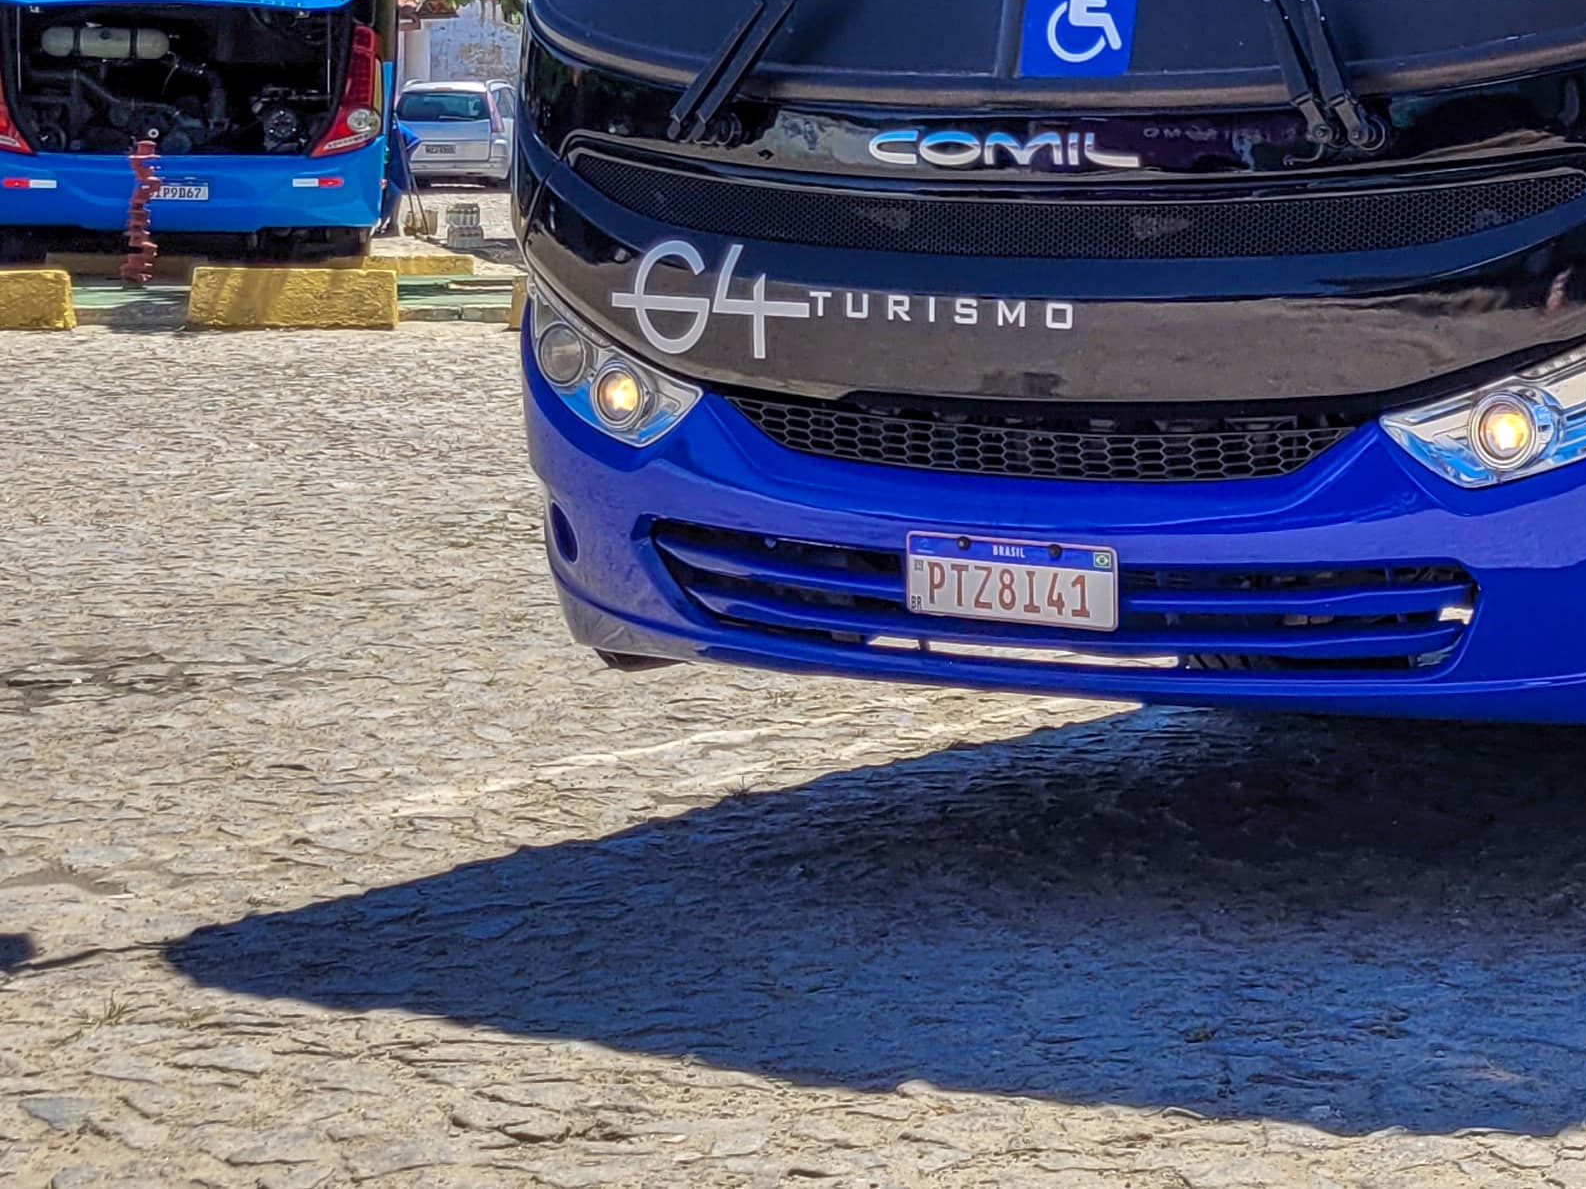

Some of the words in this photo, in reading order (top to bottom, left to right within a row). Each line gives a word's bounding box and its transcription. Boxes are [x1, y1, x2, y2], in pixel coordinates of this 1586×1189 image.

[612, 240, 810, 360] G4
[809, 291, 1074, 330] TURISMO
[993, 545, 1027, 559] BRASIL
[911, 595, 923, 610] BR
[927, 561, 1091, 618] PTZ8I41
